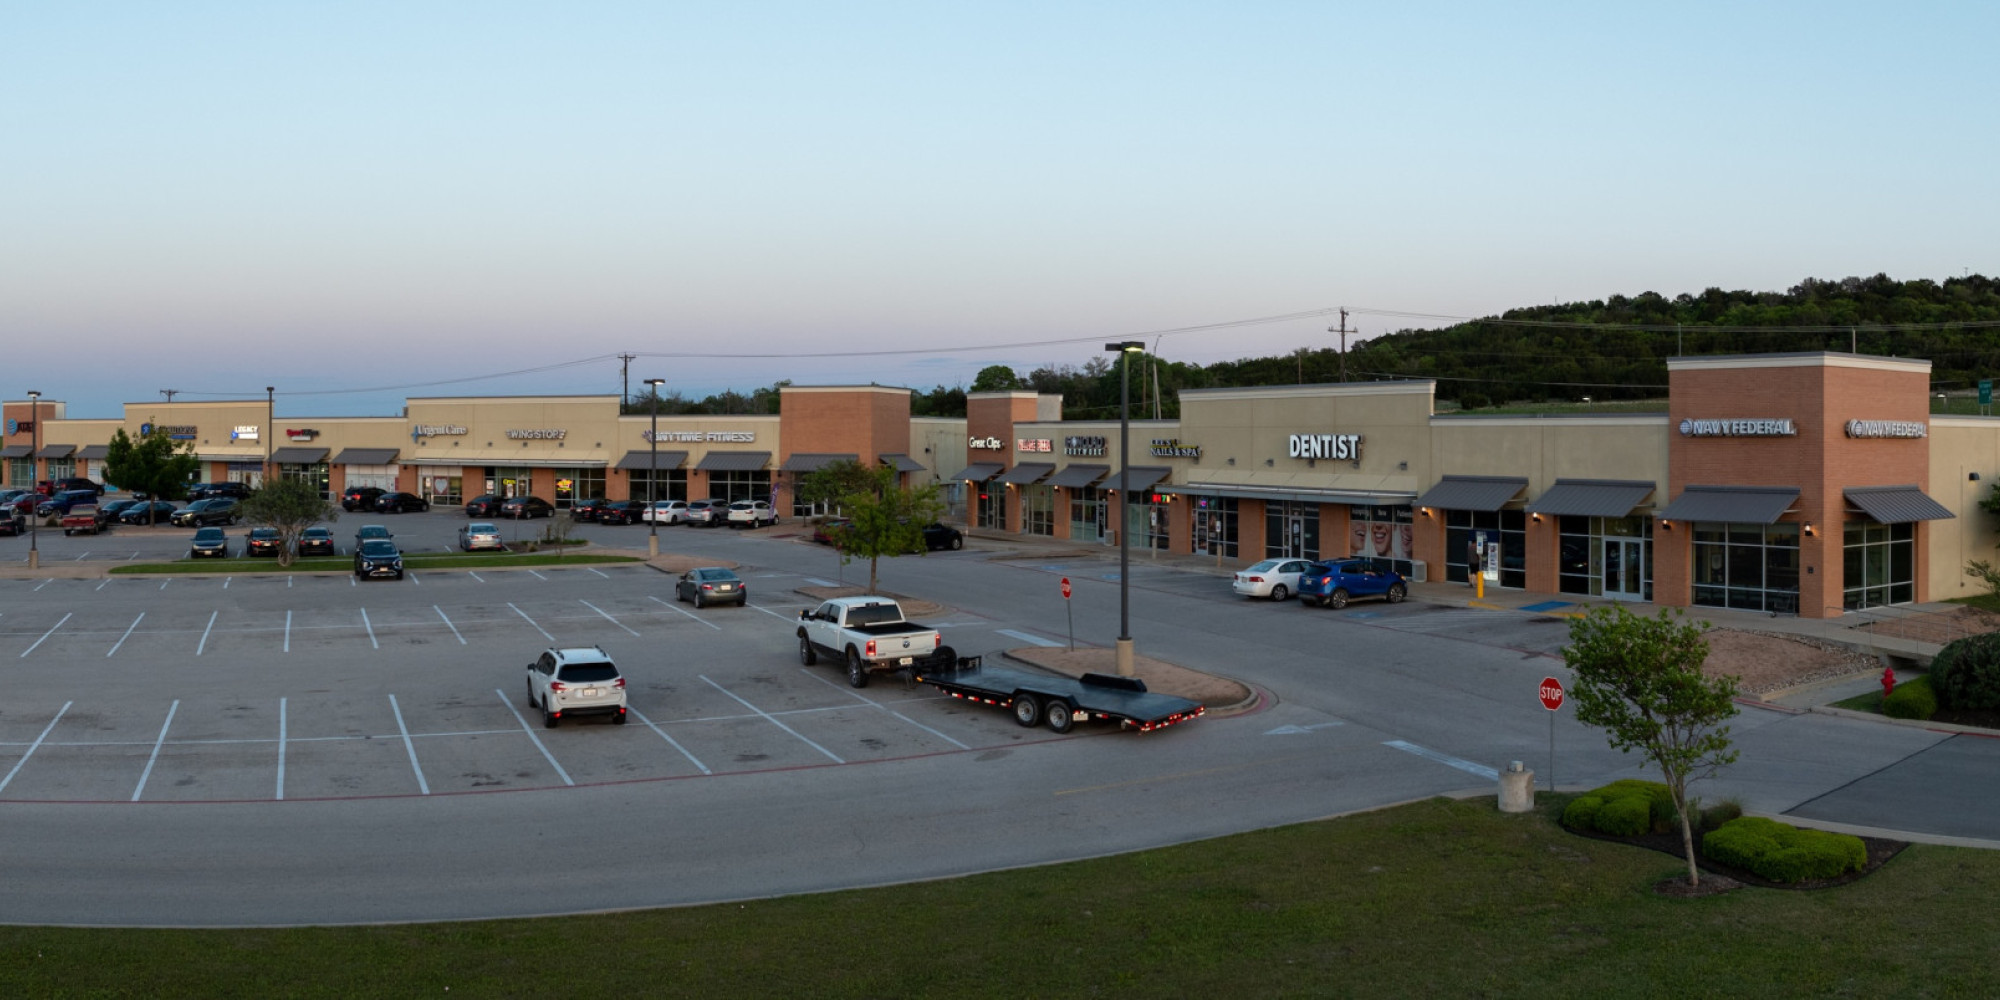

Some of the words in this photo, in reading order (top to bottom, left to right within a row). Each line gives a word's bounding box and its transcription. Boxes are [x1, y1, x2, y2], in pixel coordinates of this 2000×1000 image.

[235, 425, 259, 433] LEGACY
[418, 425, 446, 438] Urgent
[446, 425, 468, 435] Care
[1693, 419, 1732, 435] NAVY
[1732, 419, 1796, 435] FEDERAL
[1863, 421, 1890, 438] NAVY
[1891, 421, 1928, 438] FEDERAL
[706, 432, 755, 443] FITNESS
[969, 437, 986, 449] Great
[987, 437, 1002, 451] Clips
[1151, 447, 1174, 456] NAILS
[1181, 447, 1199, 457] SPA
[1289, 434, 1360, 460] DENTIST
[1541, 686, 1562, 701] STOP
